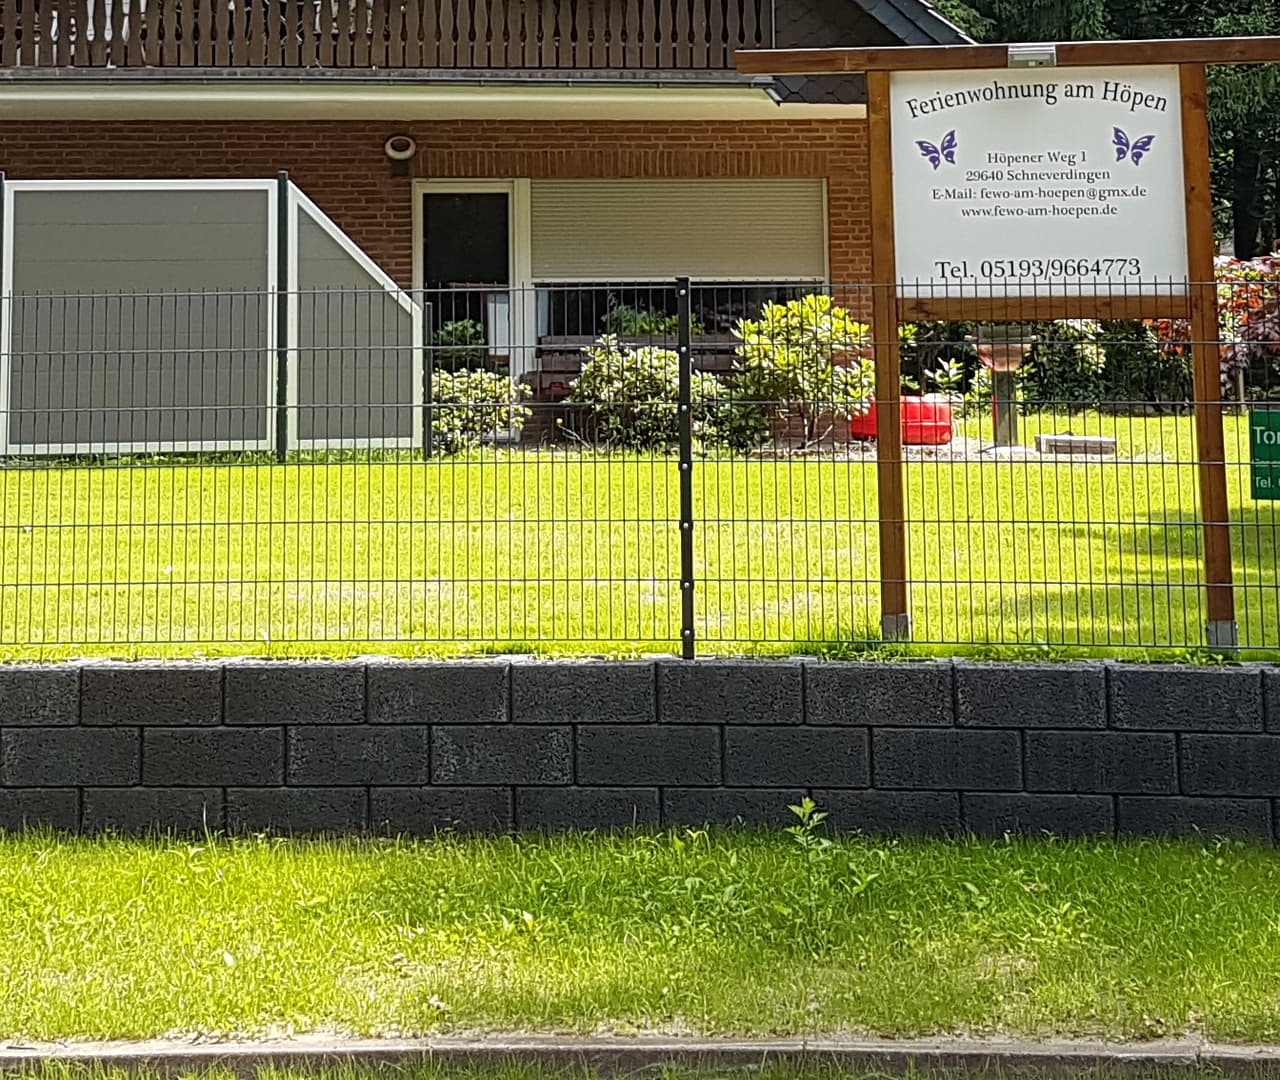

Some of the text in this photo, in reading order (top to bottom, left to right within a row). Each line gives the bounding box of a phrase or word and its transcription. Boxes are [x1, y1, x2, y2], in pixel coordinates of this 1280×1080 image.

[906, 81, 1167, 118] Ferienwohnung am Höpen
[987, 151, 1086, 166] Höpener Weg 1
[966, 169, 1110, 183] 29640 Schneverdingen
[933, 186, 1147, 201] E-Mail: fewo-am-hoepen@gmx.de
[961, 205, 1118, 218] www.fewo-am-hoepen.de
[935, 258, 1141, 280] Tel. 05193/9664773
[1256, 476, 1274, 488] Tel.
